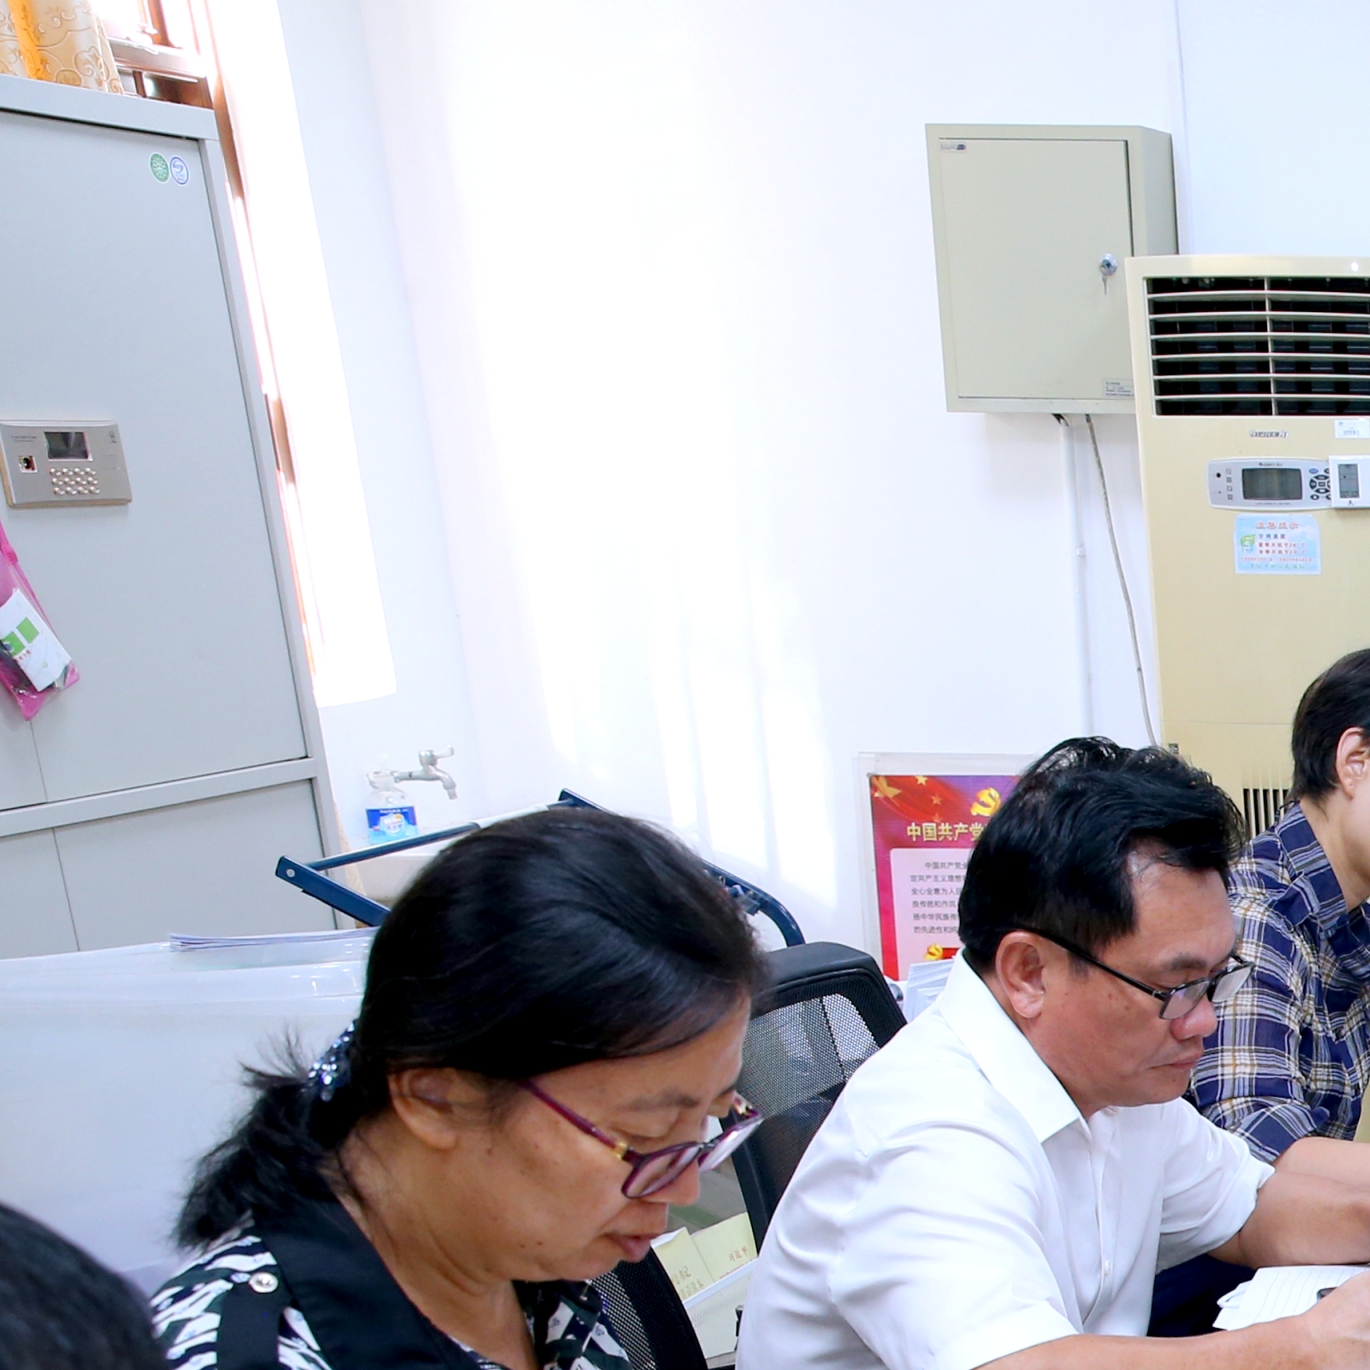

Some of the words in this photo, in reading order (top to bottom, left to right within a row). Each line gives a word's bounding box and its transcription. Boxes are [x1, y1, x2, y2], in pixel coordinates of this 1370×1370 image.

[907, 822, 985, 842] 中国共产党
[913, 913, 960, 921] 扬中华民族传
